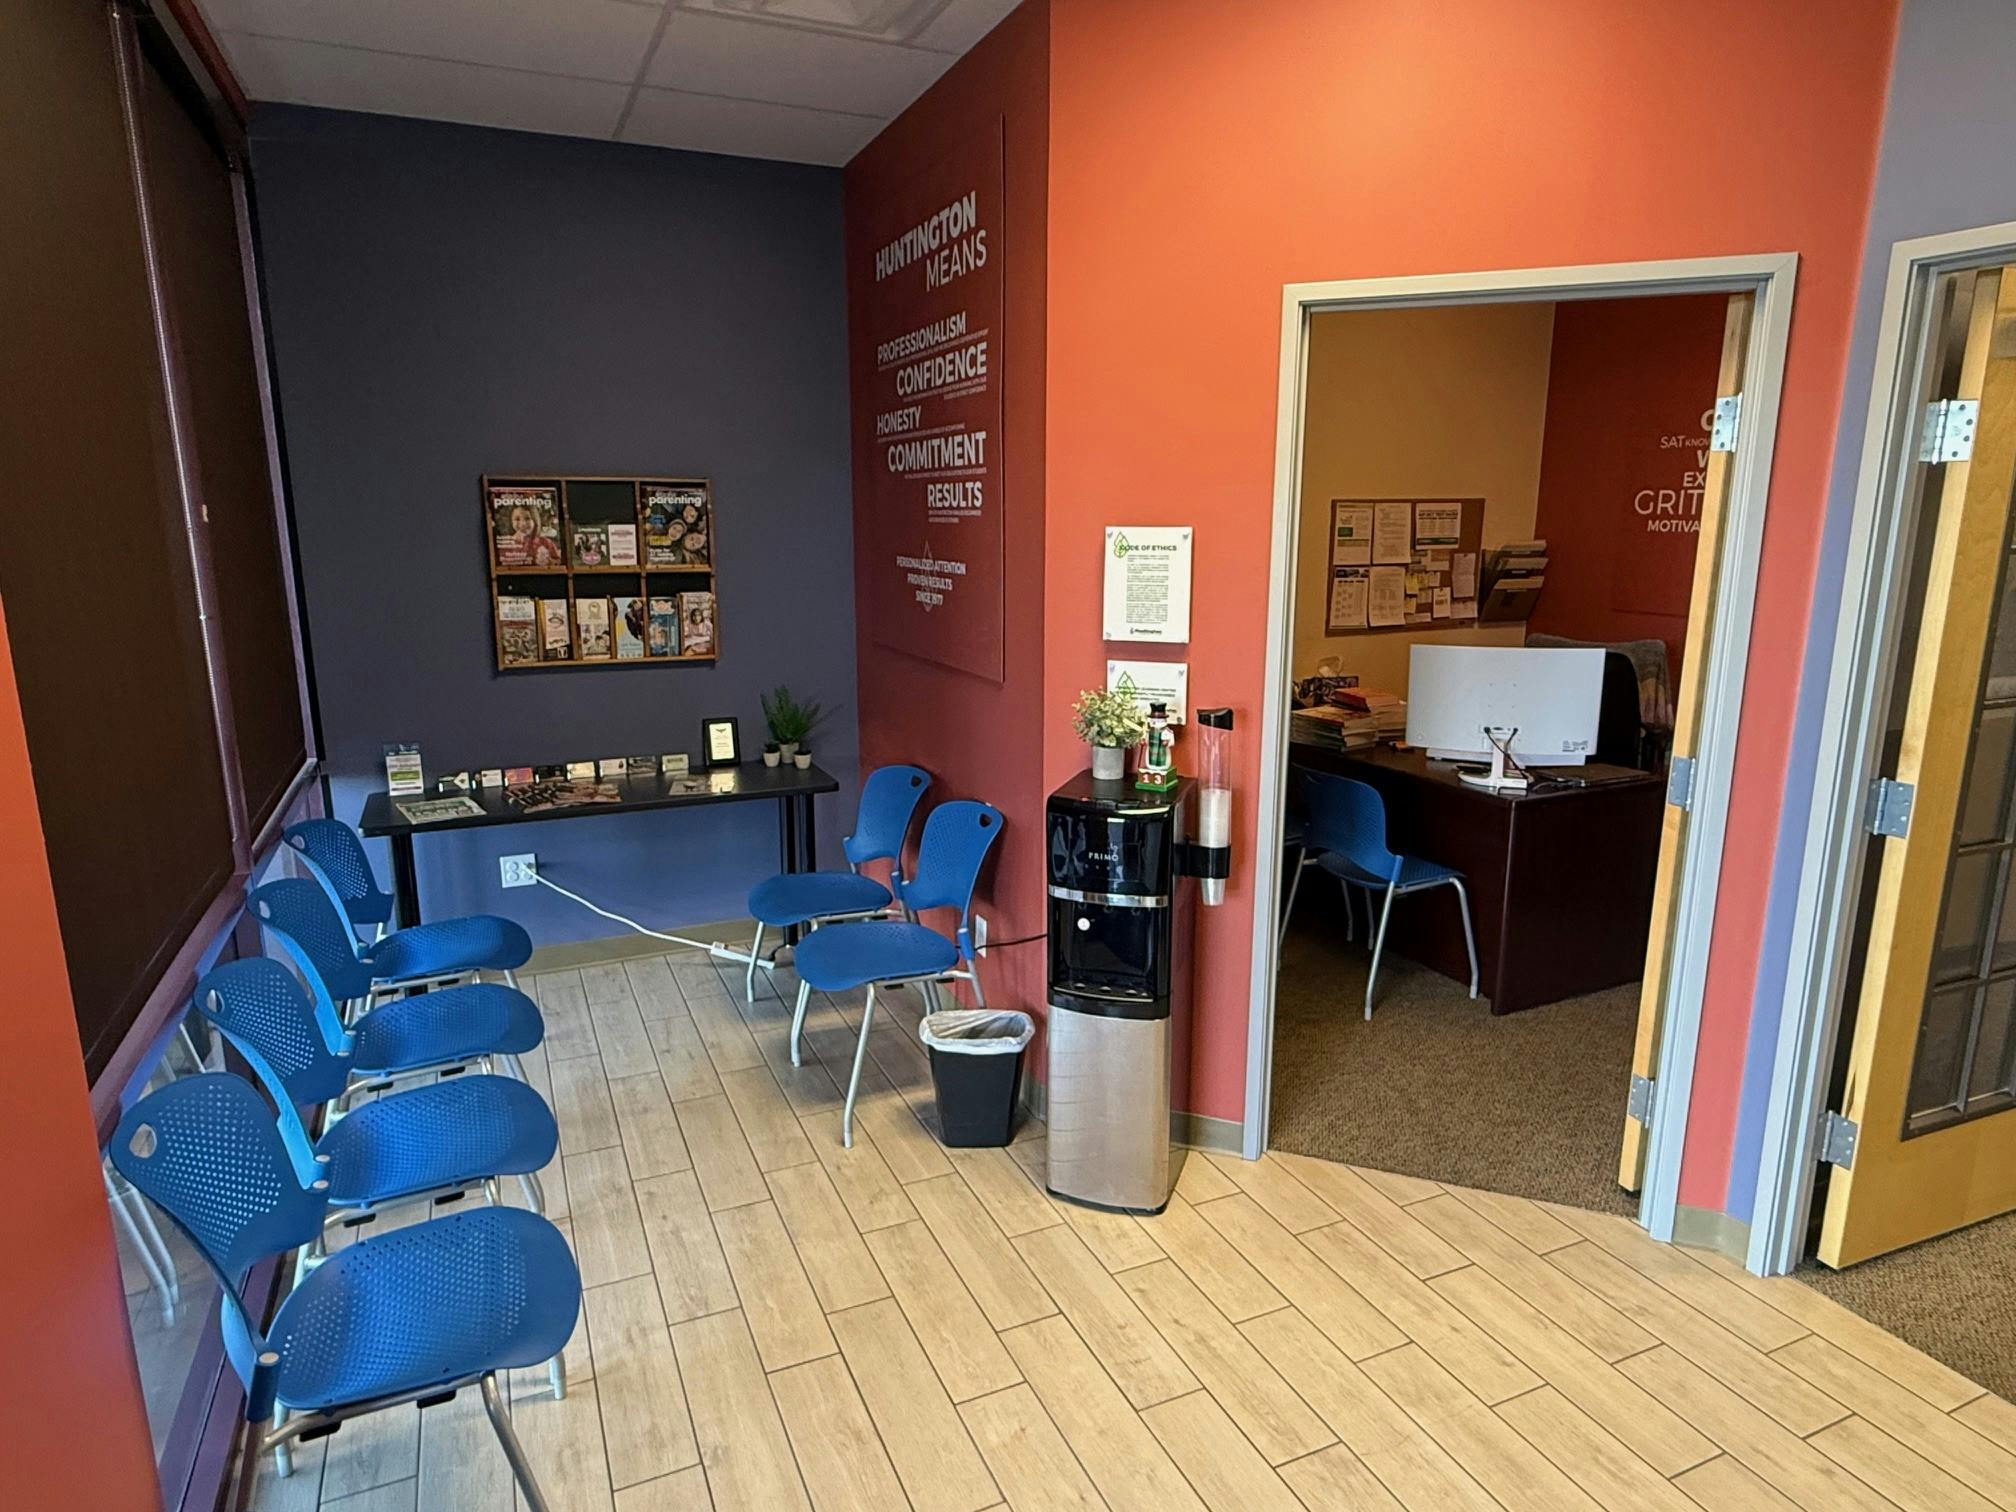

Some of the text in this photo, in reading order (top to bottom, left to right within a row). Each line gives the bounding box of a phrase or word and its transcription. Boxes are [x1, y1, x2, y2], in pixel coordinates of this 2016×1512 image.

[875, 190, 976, 282] HUNTINGTON
[926, 229, 987, 292] MEANS
[877, 311, 967, 365] PROFESSIONALISM
[896, 341, 988, 397] CONFIDENCE
[876, 404, 922, 436] HONESTY
[888, 431, 987, 473] COMMITMENT
[1660, 435, 1685, 449] SAT
[494, 495, 552, 509] parenting
[648, 493, 702, 507] parenting
[926, 481, 983, 508] RESULTS
[1634, 489, 1705, 516] GRIT
[933, 560, 967, 576] ATTENTION
[1088, 851, 1119, 862] PRIMO
